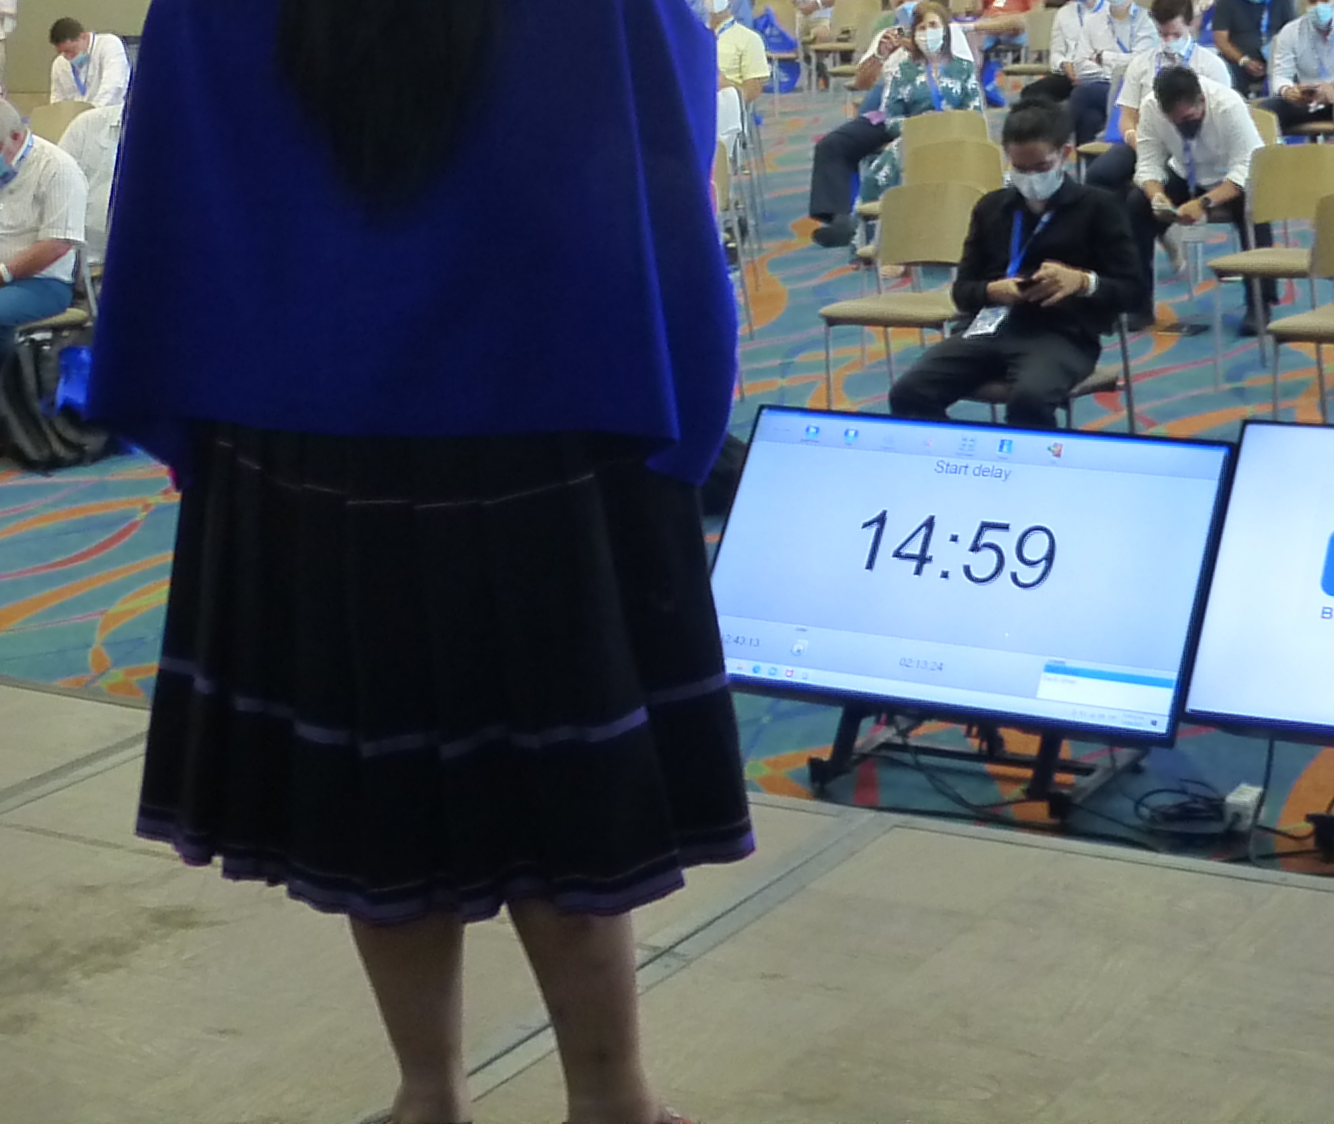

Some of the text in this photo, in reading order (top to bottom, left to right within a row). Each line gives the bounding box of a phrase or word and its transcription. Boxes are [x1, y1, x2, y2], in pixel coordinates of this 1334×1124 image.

[933, 459, 1013, 482] Start delay
[860, 508, 1058, 590] 14:59
